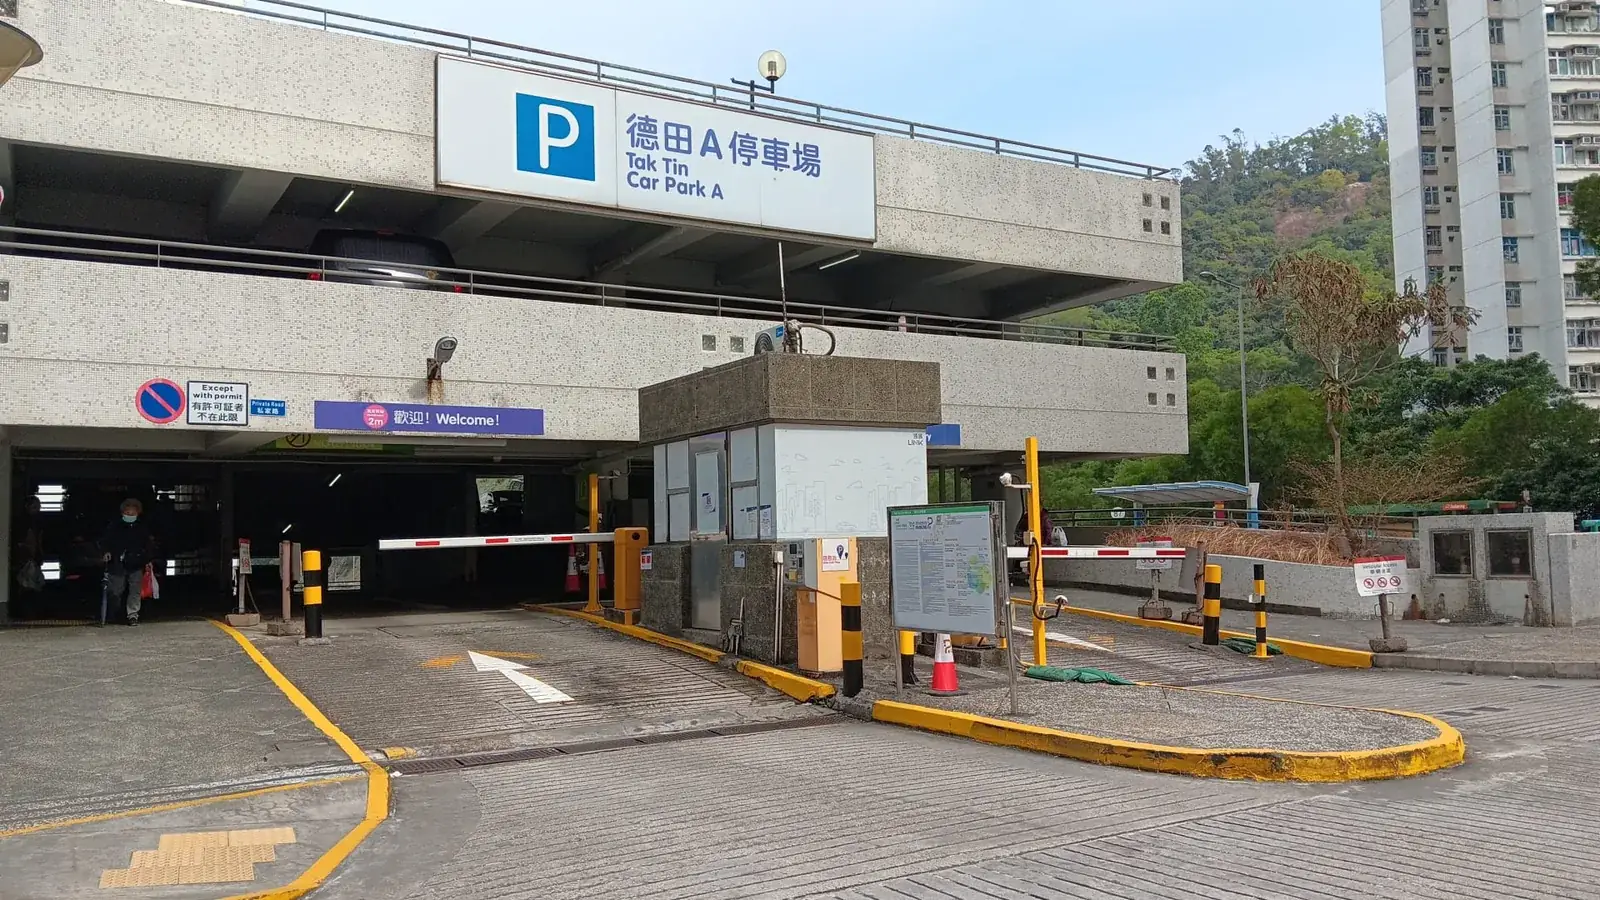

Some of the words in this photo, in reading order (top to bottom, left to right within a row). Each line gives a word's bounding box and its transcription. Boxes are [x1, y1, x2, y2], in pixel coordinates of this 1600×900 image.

[538, 103, 580, 169] P
[626, 152, 657, 172] Tak
[662, 157, 689, 177] Tin
[627, 171, 659, 190] Car
[665, 176, 706, 198] Park
[711, 183, 724, 200] A
[202, 384, 234, 393] Except
[368, 417, 383, 426] 2m
[436, 413, 499, 426] Welcome!
